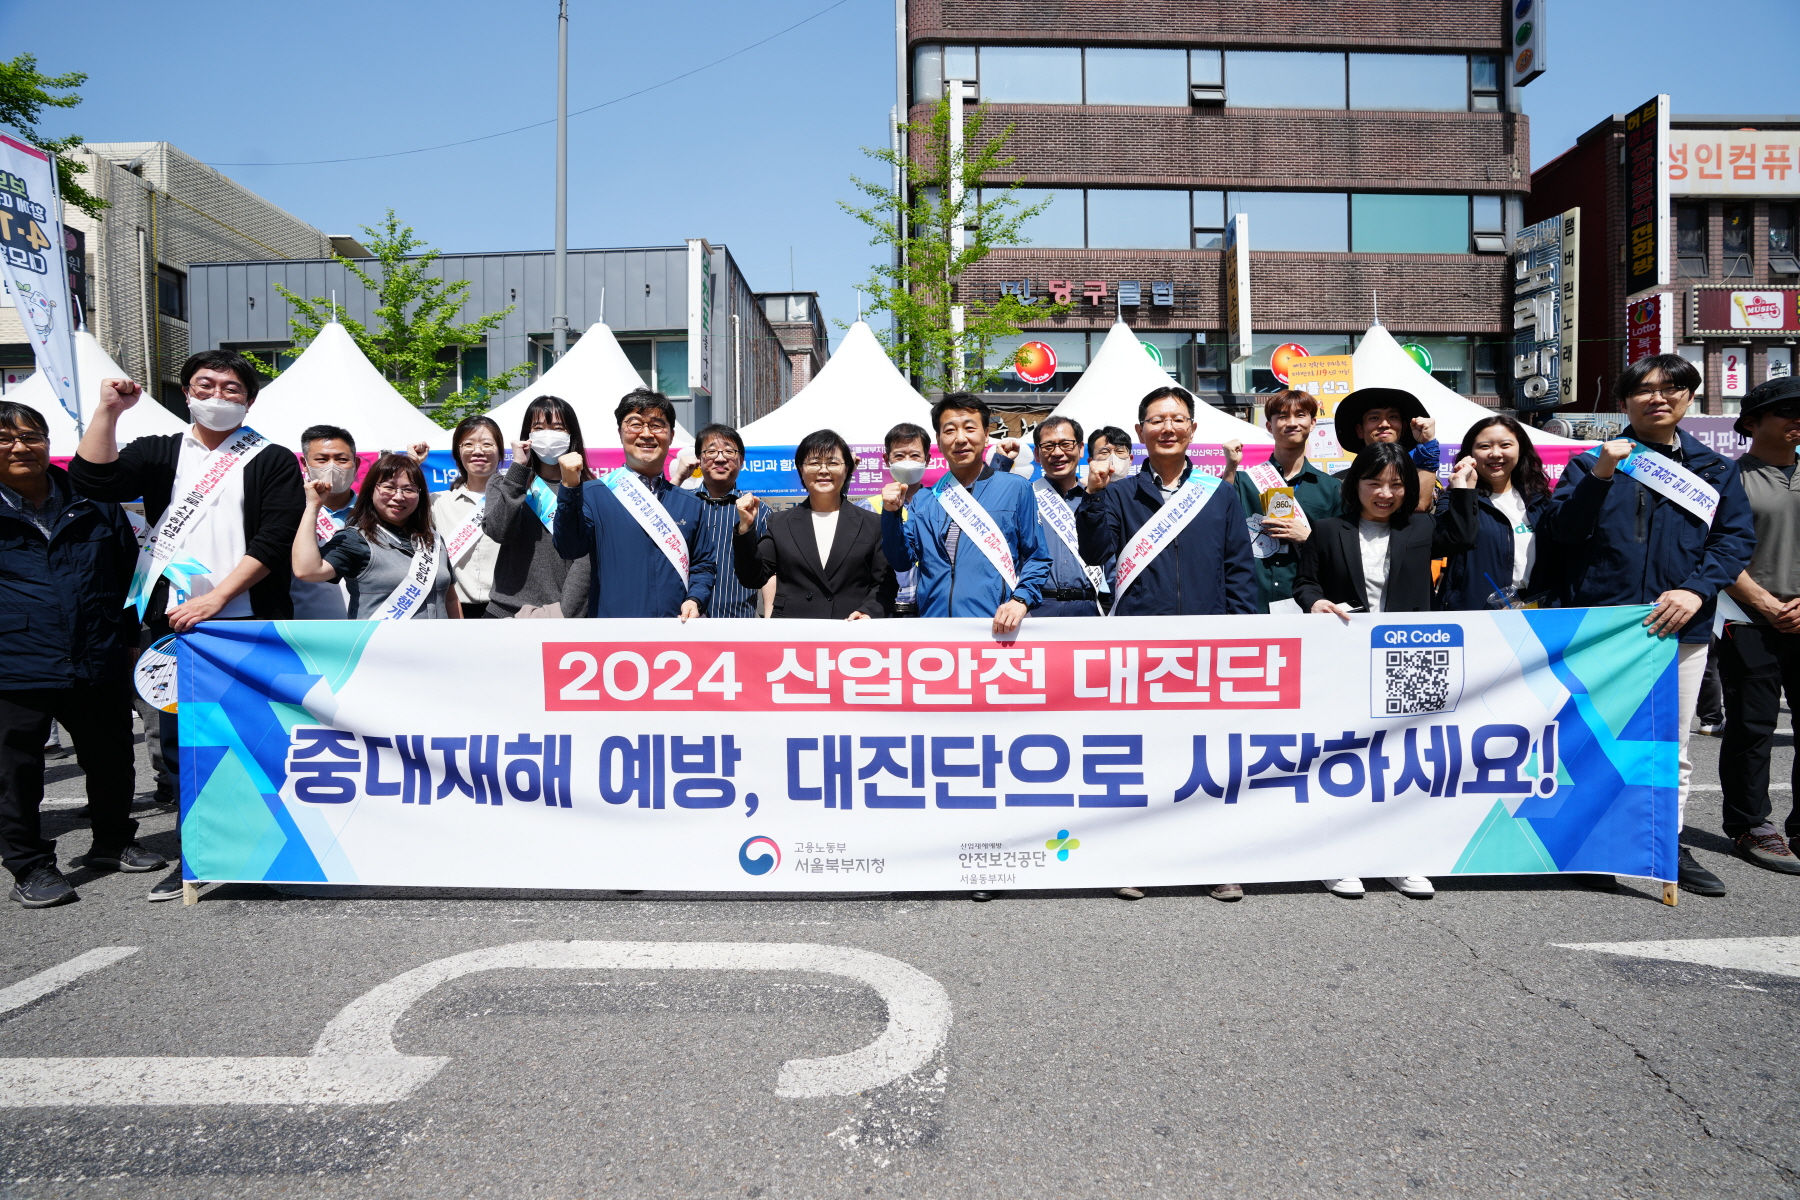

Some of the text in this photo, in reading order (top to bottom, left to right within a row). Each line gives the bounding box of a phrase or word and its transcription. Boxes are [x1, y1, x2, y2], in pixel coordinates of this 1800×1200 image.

[1669, 143, 1800, 180] 성인컴퓨
[1632, 222, 1655, 276] 전화방
[1514, 260, 1555, 398] 노래방
[1632, 323, 1656, 337] Lotto
[1316, 369, 1327, 377] 119
[1322, 380, 1350, 394] 신고
[741, 459, 777, 473] 시민과
[859, 471, 883, 484] 홍보
[1685, 484, 1716, 512] 그날까지
[160, 504, 194, 541] 시작하세요
[647, 512, 672, 538] 그날까지
[965, 512, 991, 537] 그날까지
[1145, 516, 1173, 544] 그날까지
[386, 584, 421, 620] 관행개
[1384, 629, 1451, 645] QR Code
[558, 644, 1287, 705] 2024 산업안전 대진단
[289, 723, 1557, 818] 중대재해 예방, 대진단으로 시작하세요!
[794, 842, 847, 854] 고용노동부
[960, 842, 1002, 850] 산업재해예방
[794, 857, 885, 874] 서울북부지청
[958, 851, 1047, 869] 안전보건공단
[959, 873, 1016, 885] 서울동부지사
